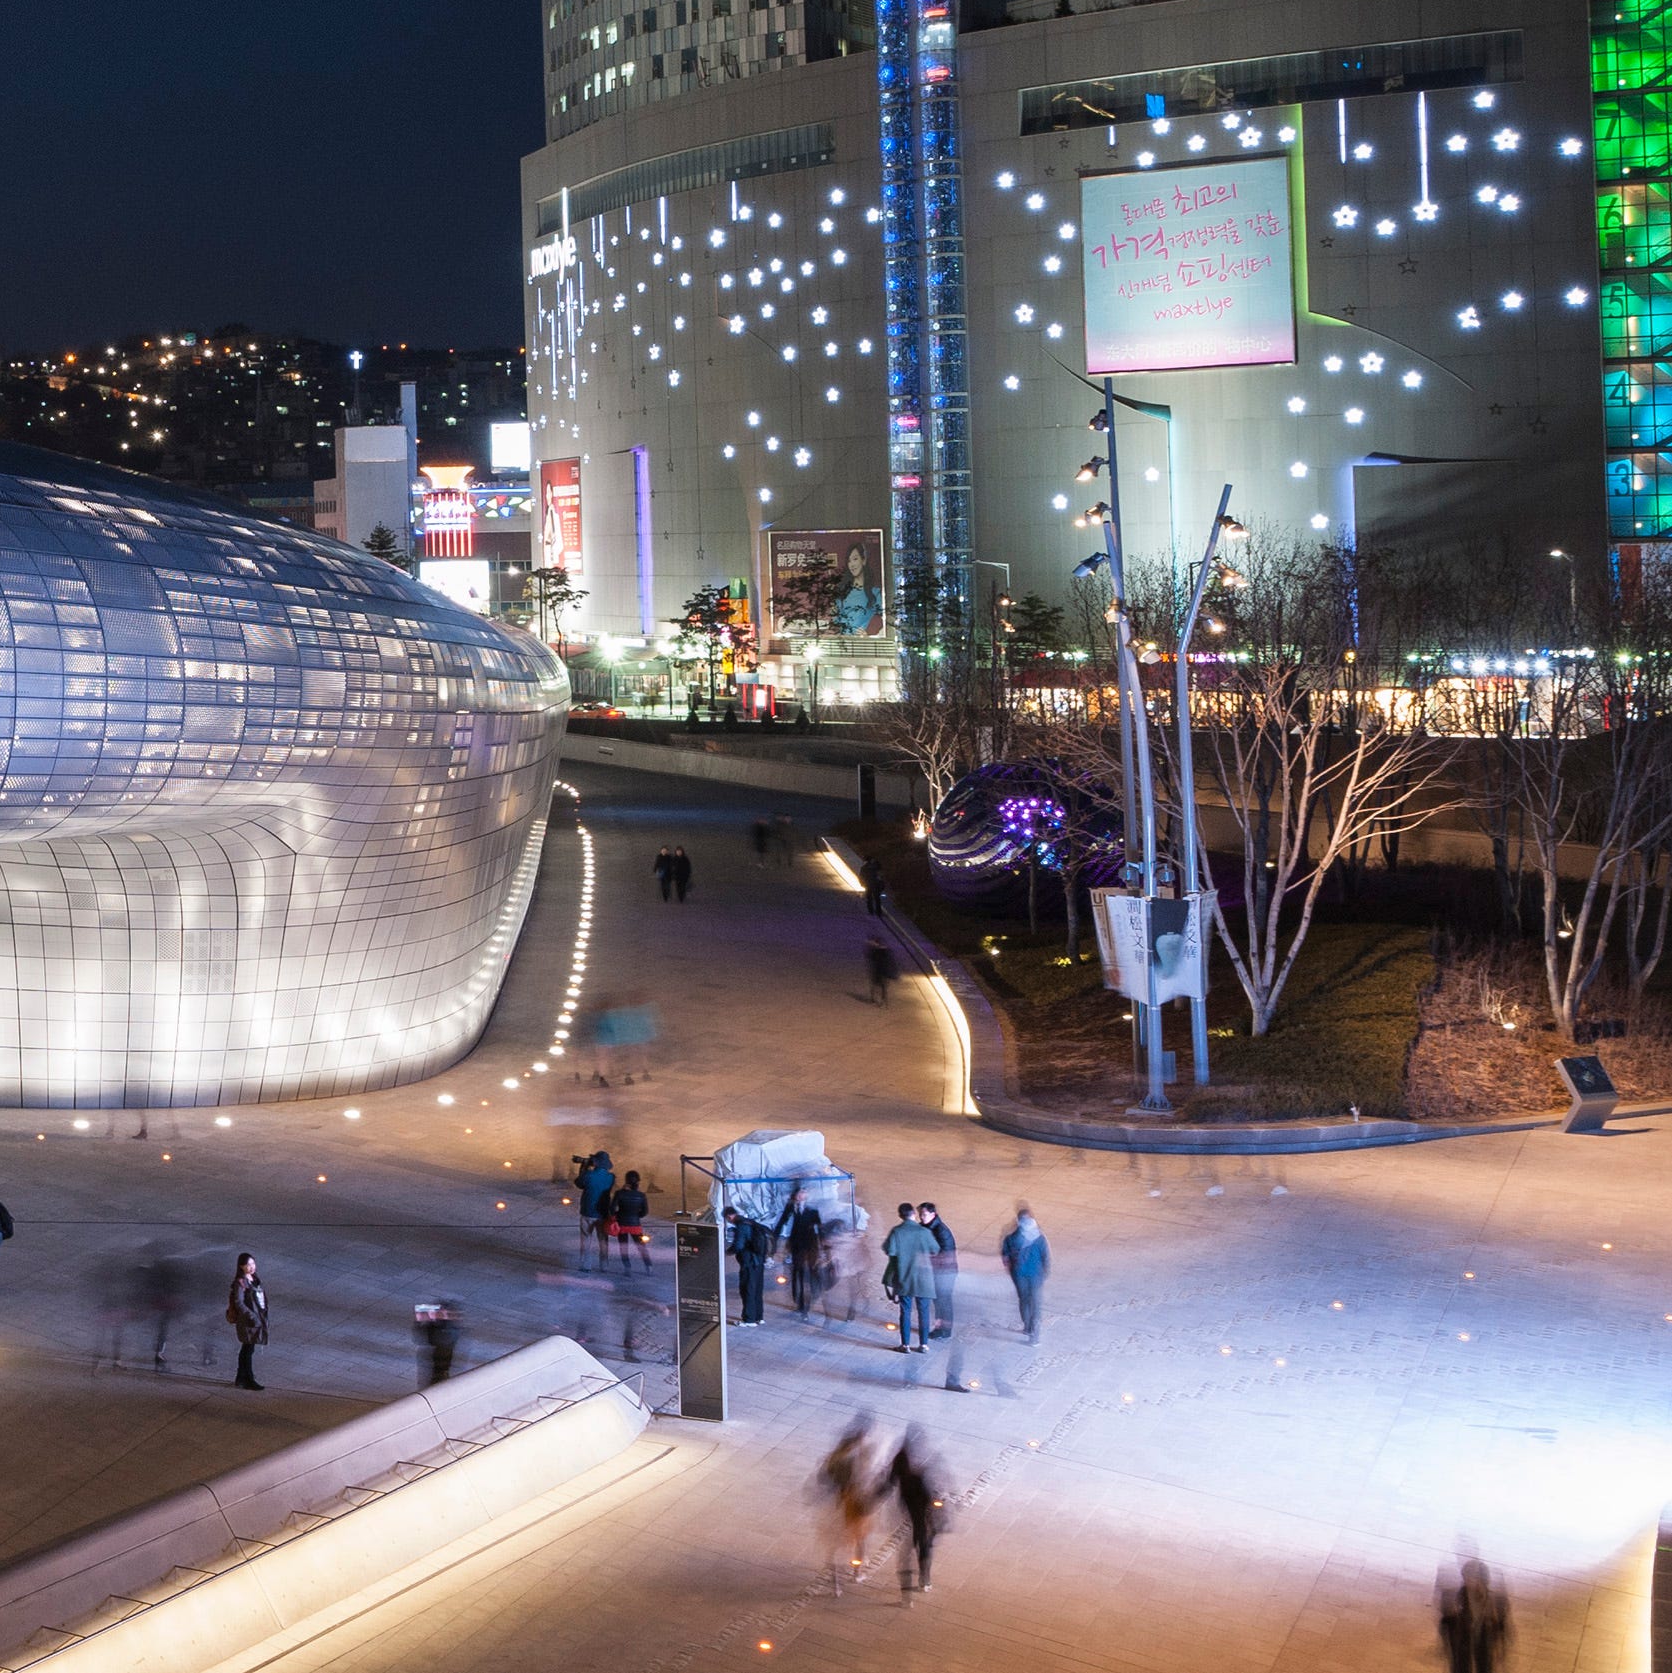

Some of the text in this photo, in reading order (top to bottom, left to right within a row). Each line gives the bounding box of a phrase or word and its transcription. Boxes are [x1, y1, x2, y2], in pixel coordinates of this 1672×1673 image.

[1596, 109, 1620, 141] 7
[1121, 183, 1238, 227] 동대문 최고의
[1604, 197, 1623, 232] 6
[1091, 225, 1169, 269] 가격
[1245, 209, 1284, 238] 갖춘
[1118, 253, 1272, 300] 신개념 쇼핑센터
[1609, 285, 1624, 318] 5
[1608, 373, 1629, 407] 4
[1614, 464, 1630, 496] 3
